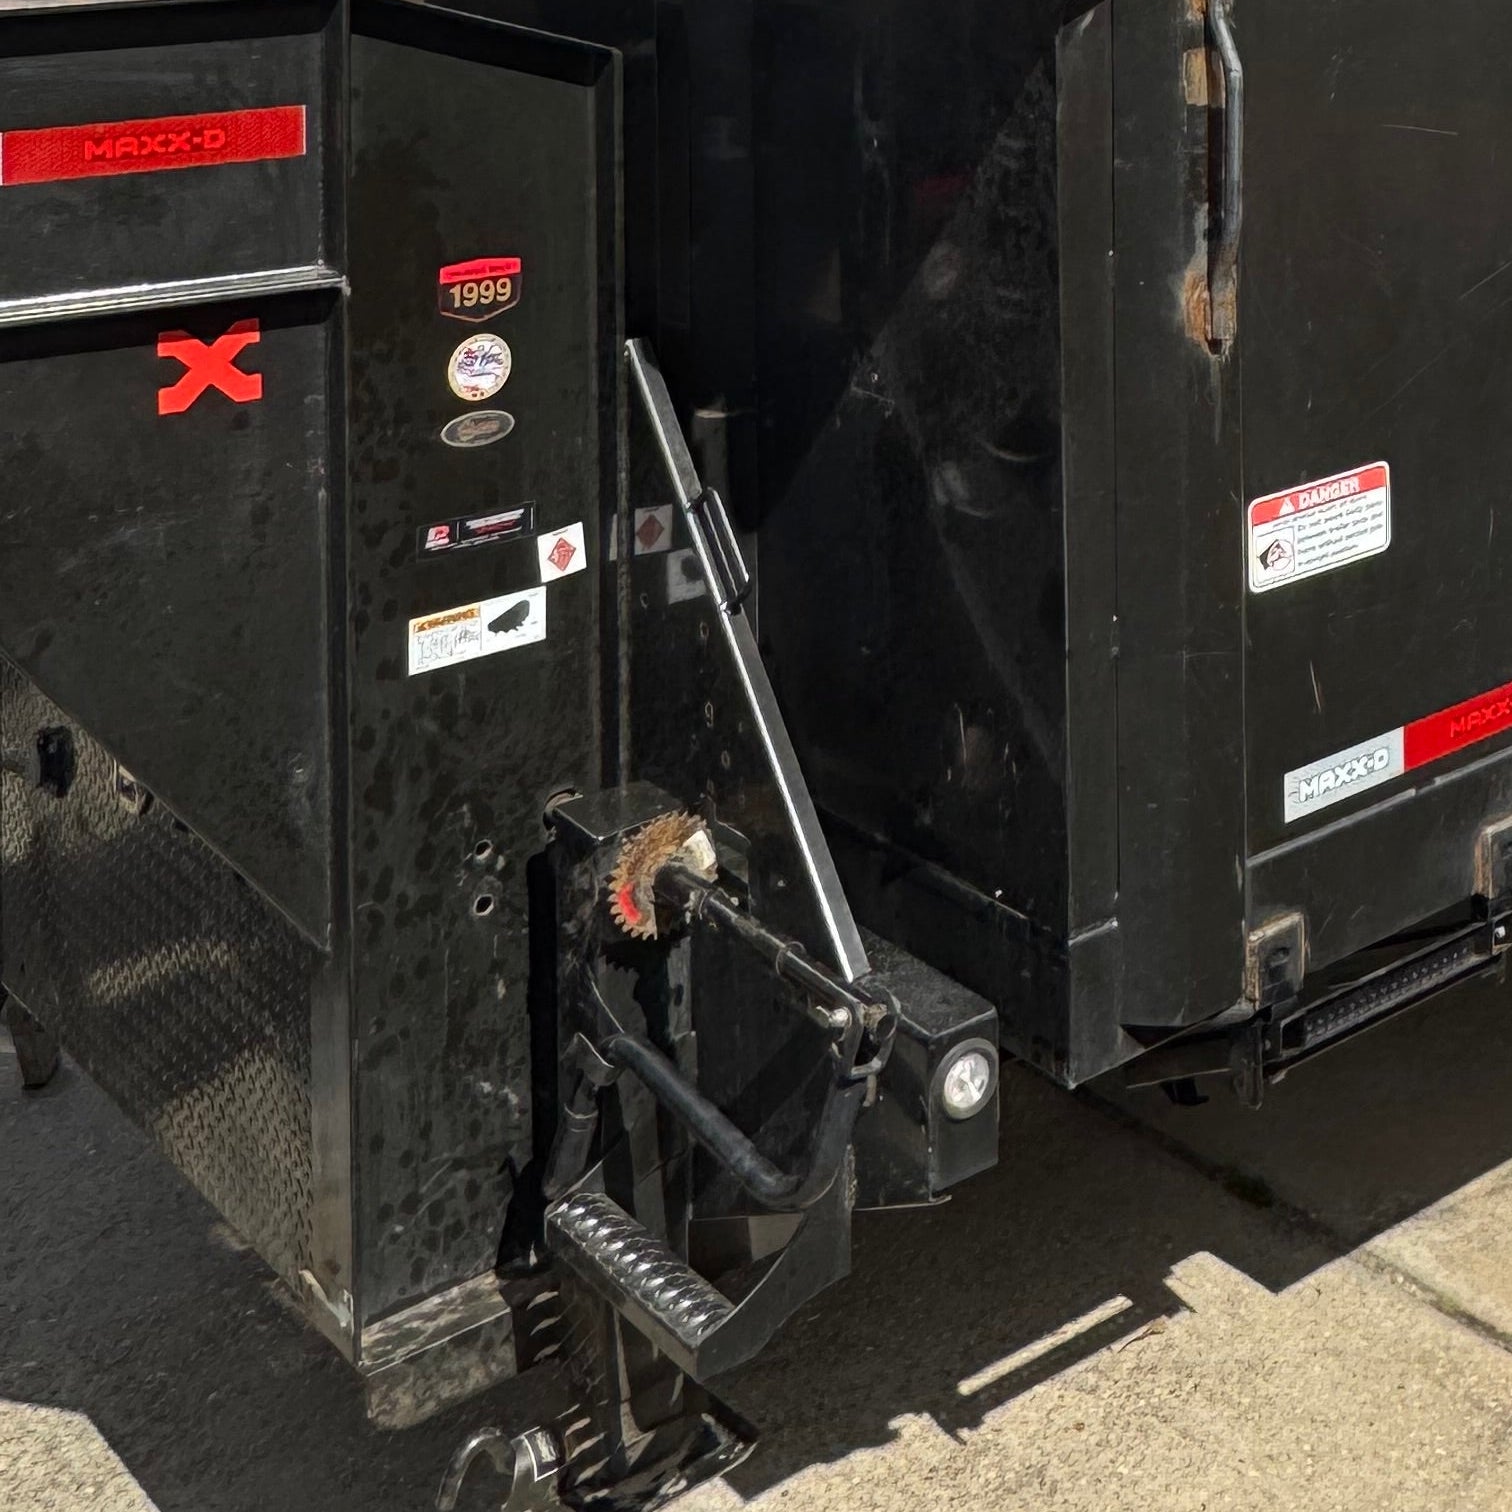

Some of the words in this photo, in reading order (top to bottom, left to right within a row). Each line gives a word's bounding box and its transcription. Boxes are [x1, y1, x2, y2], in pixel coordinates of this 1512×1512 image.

[84, 128, 226, 161] MAXX-D
[449, 277, 512, 309] 1999
[1298, 477, 1360, 510] DANGER
[1299, 748, 1390, 803] MAXX-D
